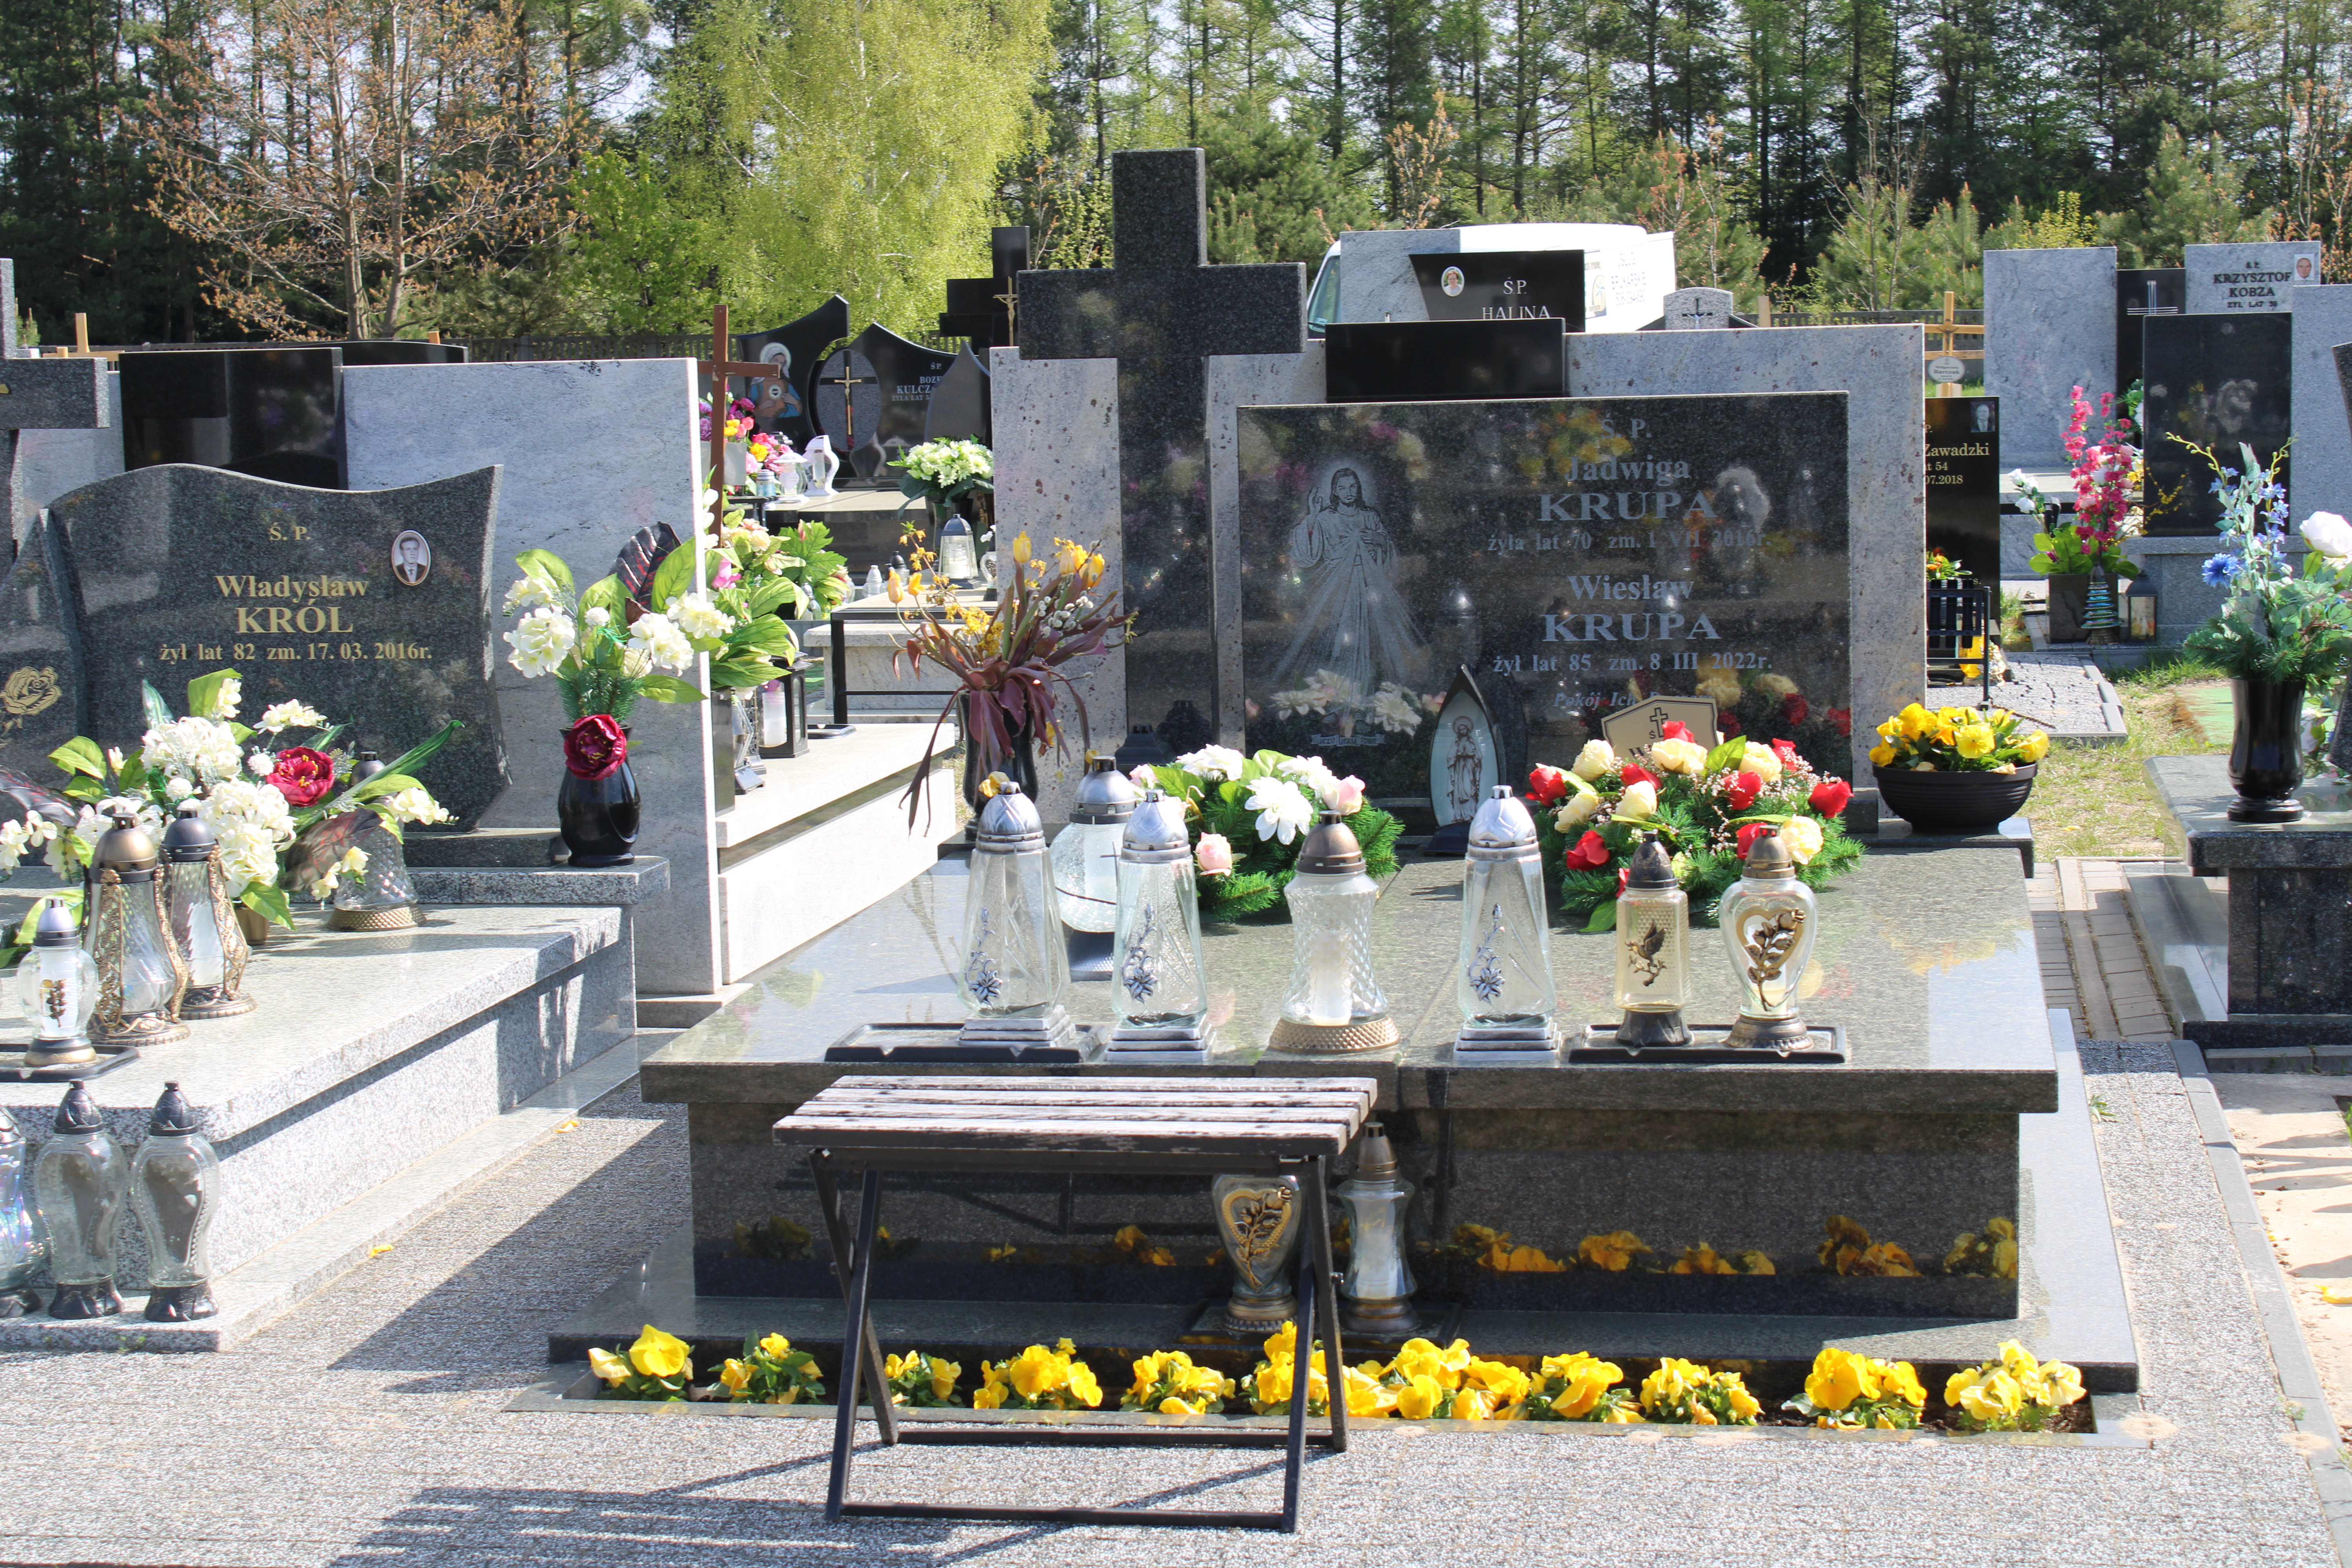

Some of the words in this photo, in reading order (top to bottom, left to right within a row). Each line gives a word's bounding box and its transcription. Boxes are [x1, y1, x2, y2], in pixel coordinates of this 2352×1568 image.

[2213, 272, 2292, 283] KRZYSZTOF
[2229, 287, 2276, 297] KOBZA
[1482, 305, 1550, 319] HALINA
[1925, 443, 1990, 457] Zawadzki
[1564, 454, 1690, 486] Jadwiga
[1935, 462, 1948, 470] 54
[1537, 490, 1718, 521] KRUPA
[1488, 535, 1524, 555] żyła
[1536, 533, 1559, 550] lat
[1572, 533, 1592, 549] 70
[1608, 535, 1641, 549] zm.
[1649, 531, 1656, 548] 1
[1670, 530, 1701, 547] VII
[215, 575, 369, 603] Władysław
[1568, 574, 1695, 601] Wiesław
[236, 598, 353, 633] KRÓL
[1542, 612, 1722, 642] KRUPA
[160, 644, 187, 665] żył
[198, 644, 223, 661] lat
[234, 643, 256, 661] 82
[267, 648, 301, 661] zm.
[374, 642, 432, 659] 2016r.
[1493, 655, 1521, 677] żył
[1533, 654, 1557, 671] lat
[1569, 654, 1592, 671] 85
[1609, 657, 1643, 671] zm.
[1650, 653, 1661, 670] 8
[1674, 652, 1699, 670] III
[1711, 652, 1772, 669] 2022r.
[1553, 691, 1601, 710] Pokój
[1609, 691, 1637, 706] Ich
